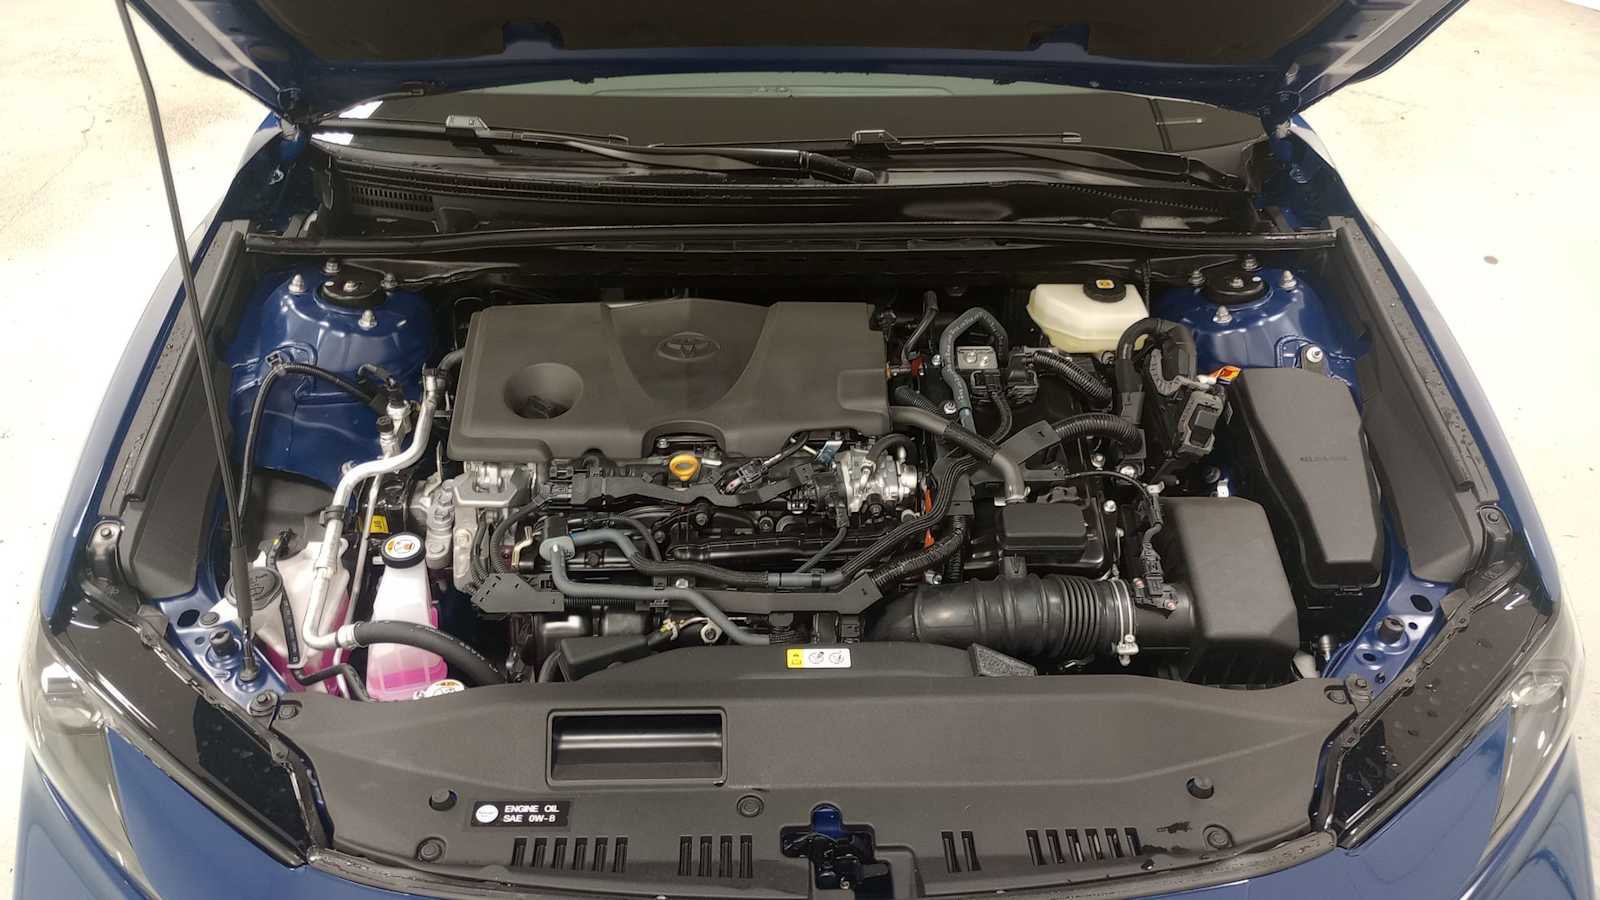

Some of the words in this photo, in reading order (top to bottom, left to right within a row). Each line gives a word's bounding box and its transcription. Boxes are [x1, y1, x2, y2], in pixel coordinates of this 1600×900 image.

[504, 804, 539, 813] ENGINE
[544, 804, 560, 813] OIL
[503, 814, 523, 823] SAE
